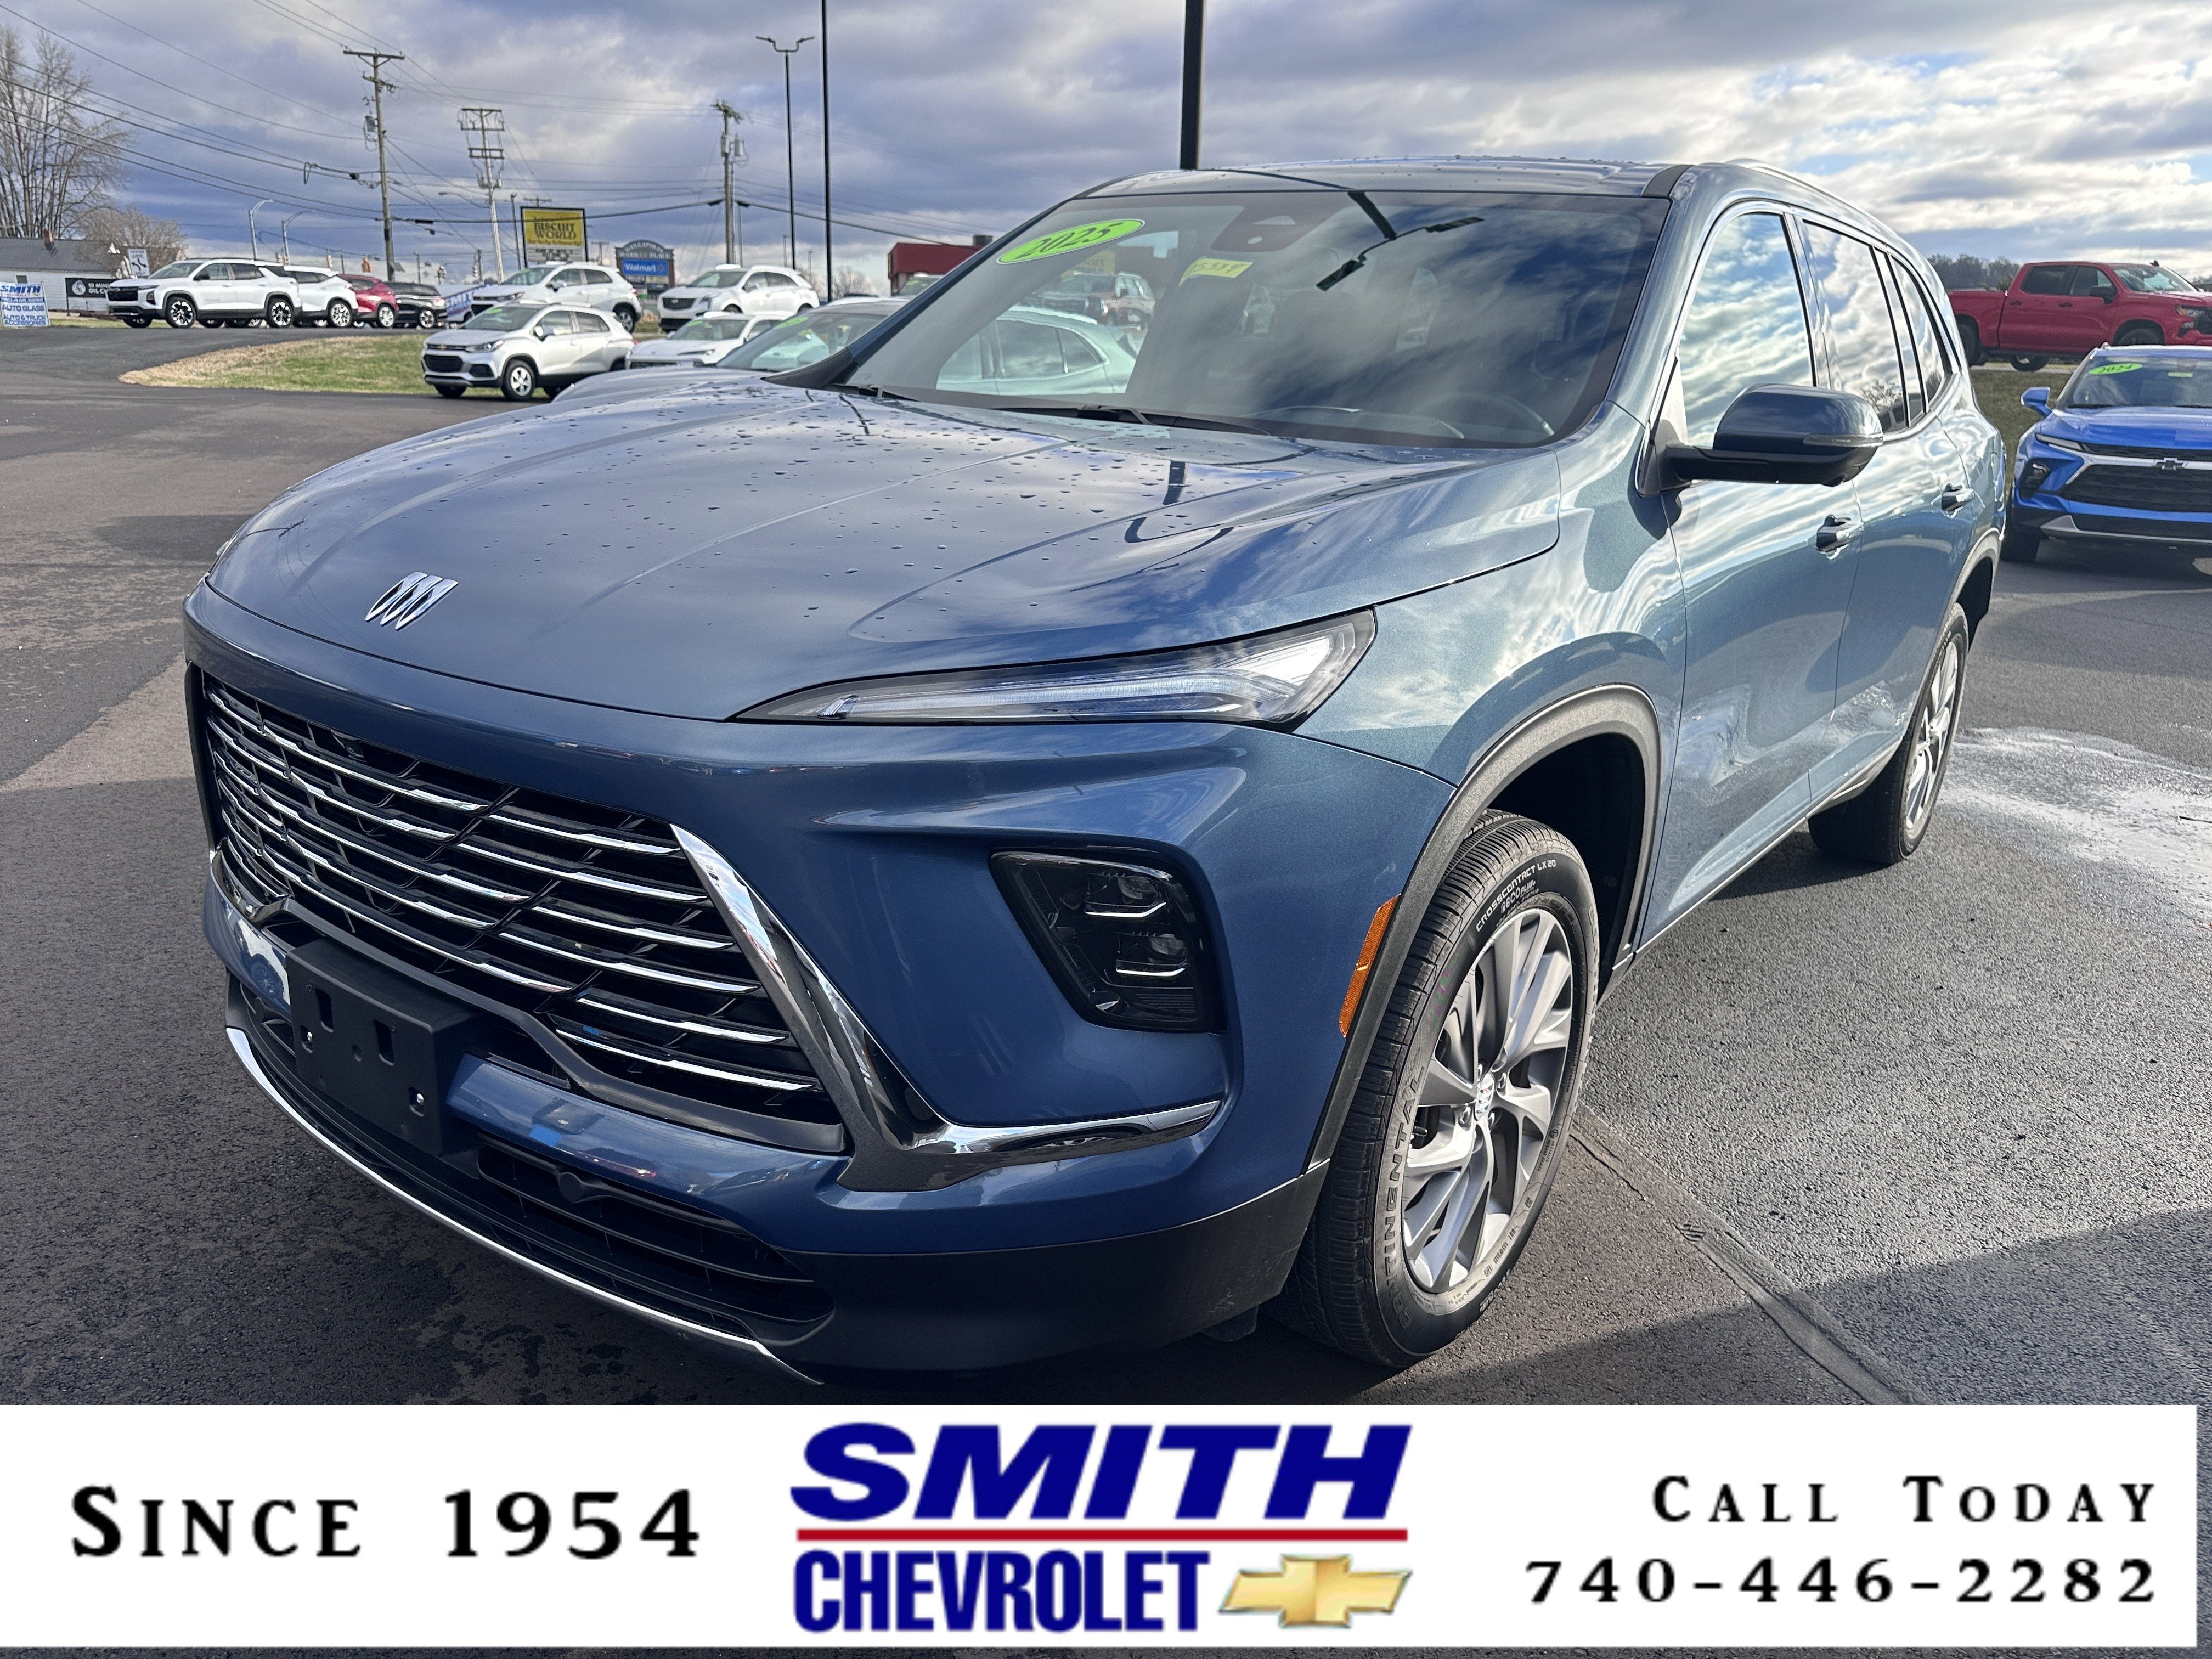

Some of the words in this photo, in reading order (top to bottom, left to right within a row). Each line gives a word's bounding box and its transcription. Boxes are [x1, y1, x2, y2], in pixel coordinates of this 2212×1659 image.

[535, 231, 577, 239] WORLD
[1013, 222, 1125, 260] 2025
[624, 262, 657, 272] Walmart
[0, 285, 41, 294] SMITH
[1476, 865, 1536, 932] CROSSCONTACT
[1385, 1066, 1425, 1329] CONTINENTAL
